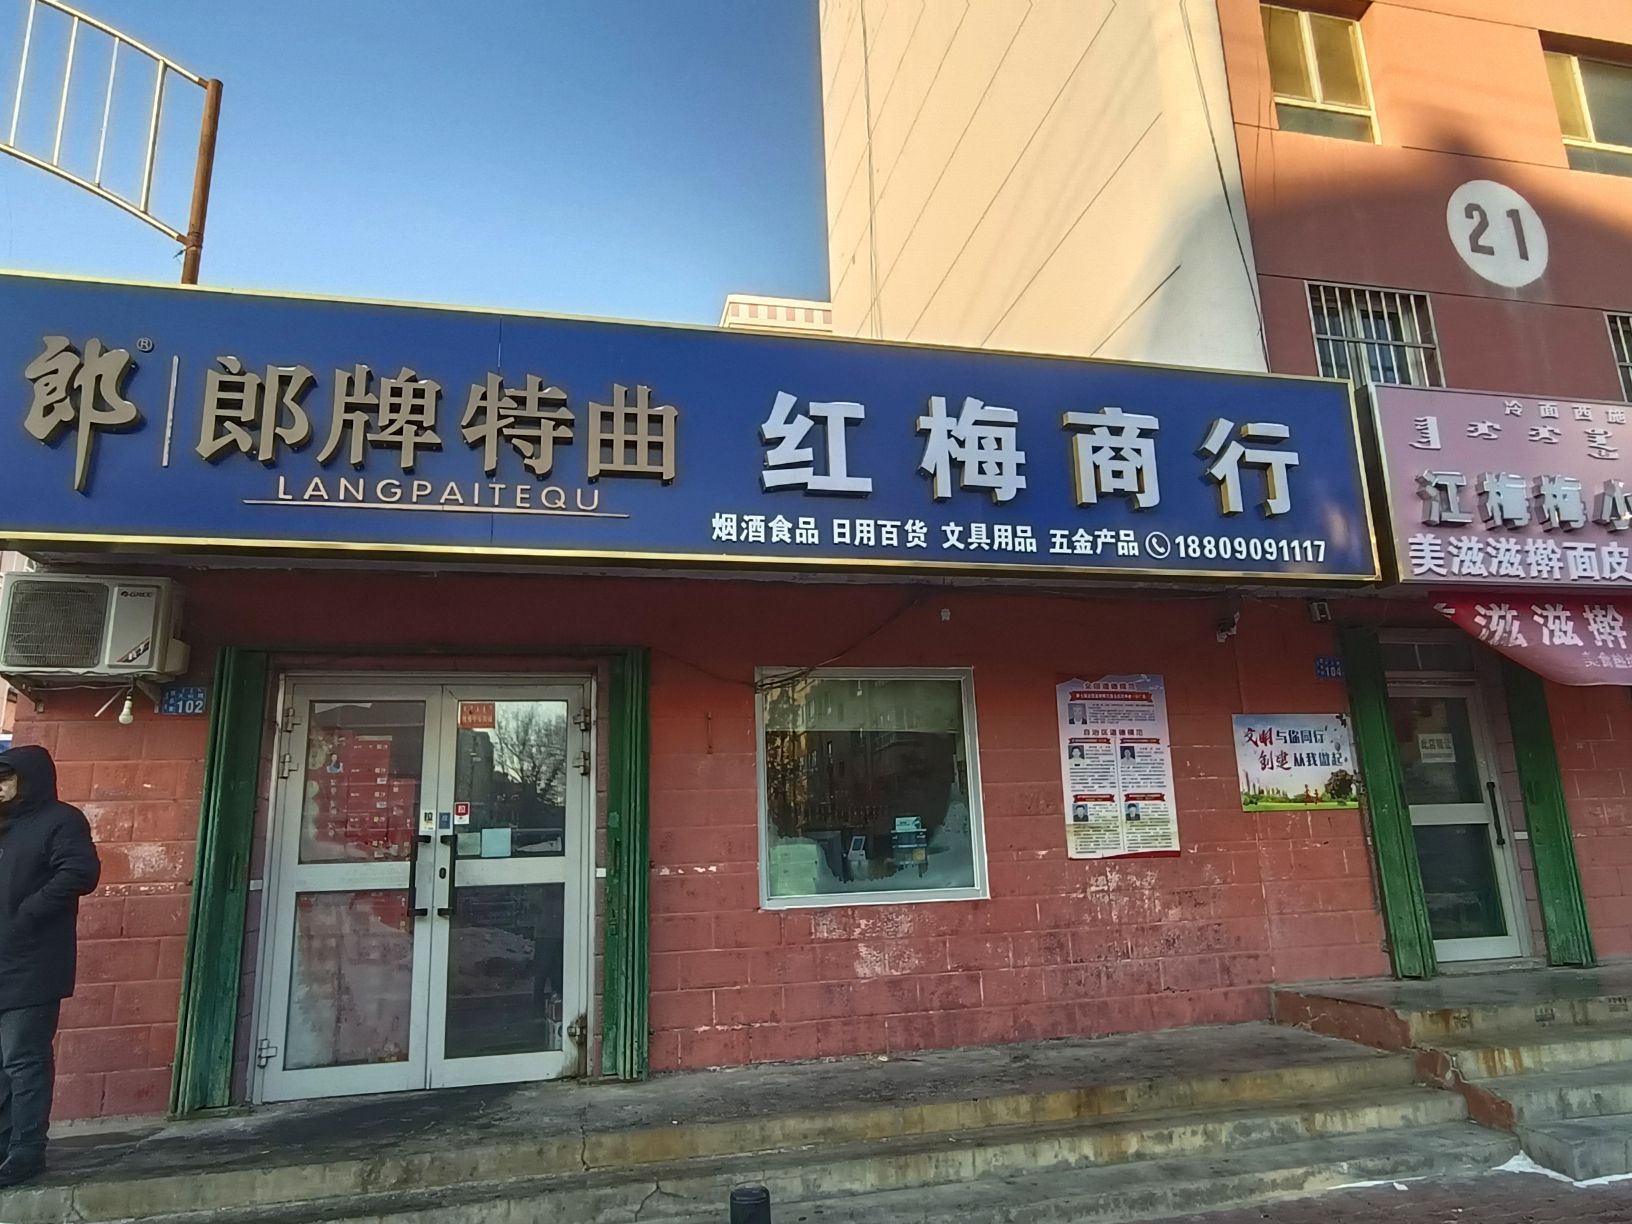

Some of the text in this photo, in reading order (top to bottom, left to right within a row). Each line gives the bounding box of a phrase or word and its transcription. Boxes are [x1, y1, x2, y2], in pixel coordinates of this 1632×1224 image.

[1464, 203, 1529, 262] 21
[195, 356, 679, 486] 郎牌特曲
[1504, 400, 1627, 424] 冷面西施
[760, 390, 1300, 519] 红梅商行
[276, 475, 601, 511] LANGPAITEQU
[712, 512, 1325, 563] 烟酒食品 日用百货 文具用品 五金产品 18809091117
[1408, 532, 1632, 582] 美滋滋擀面皮
[1433, 602, 1628, 650] 滋滋擀
[176, 699, 204, 713] 102
